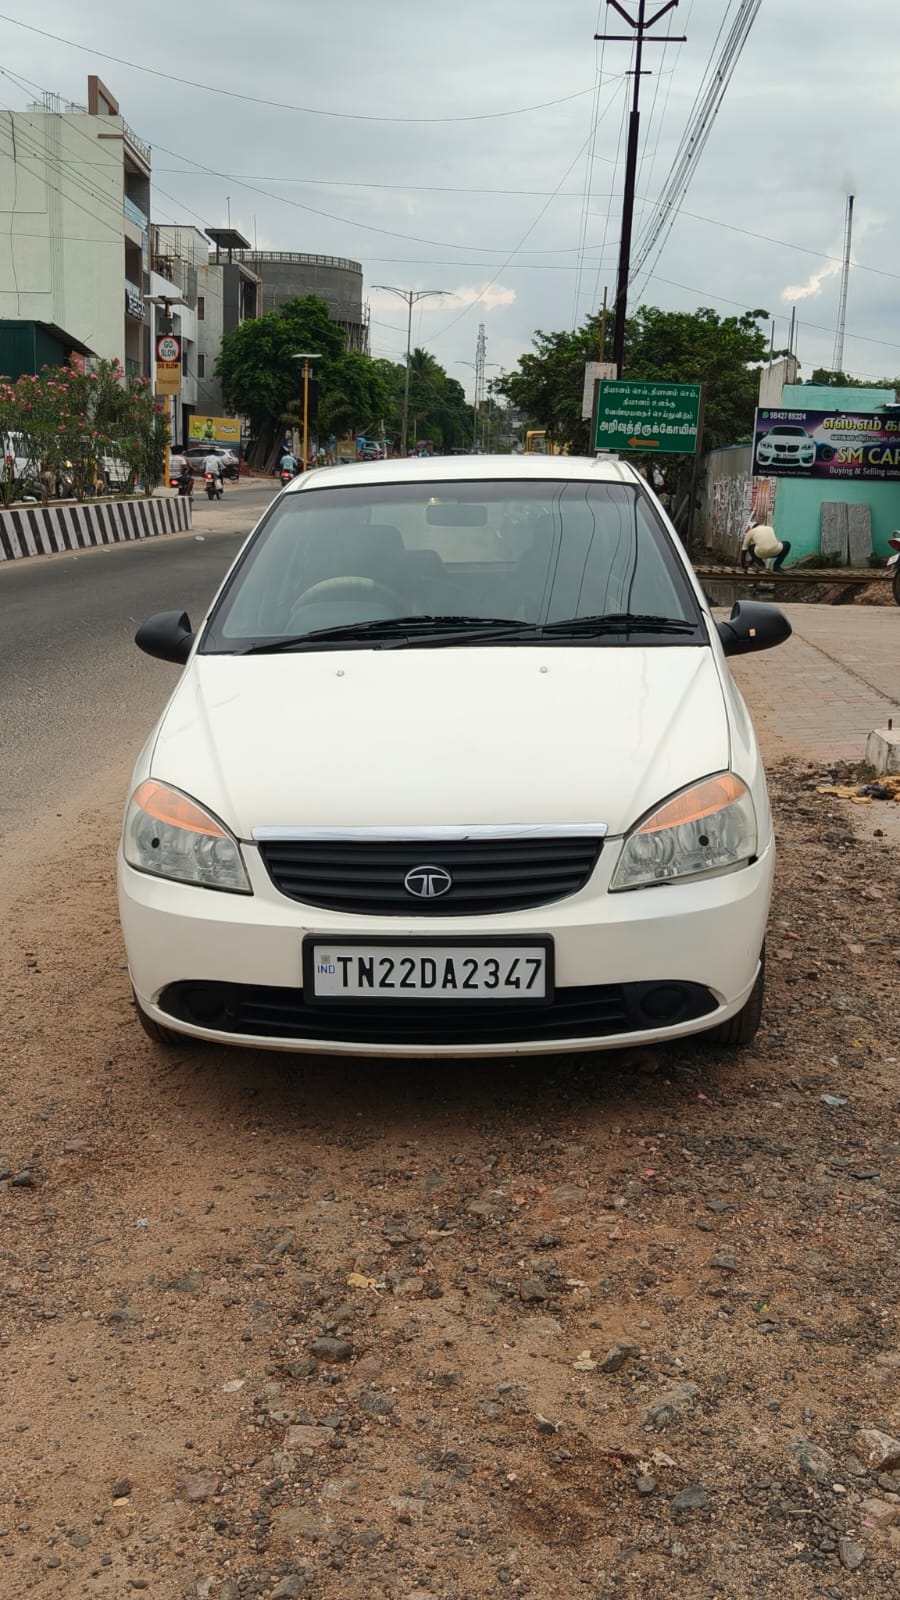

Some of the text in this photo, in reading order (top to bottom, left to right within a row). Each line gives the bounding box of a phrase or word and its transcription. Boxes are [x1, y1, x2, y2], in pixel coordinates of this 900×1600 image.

[163, 340, 174, 349] GO
[161, 349, 177, 358] SLOW
[838, 446, 865, 465] SM
[829, 465, 854, 477] Buying
[854, 466, 861, 475] &
[863, 466, 886, 477] Selling
[317, 964, 336, 975] IND
[337, 956, 543, 990] TN22DA2347
